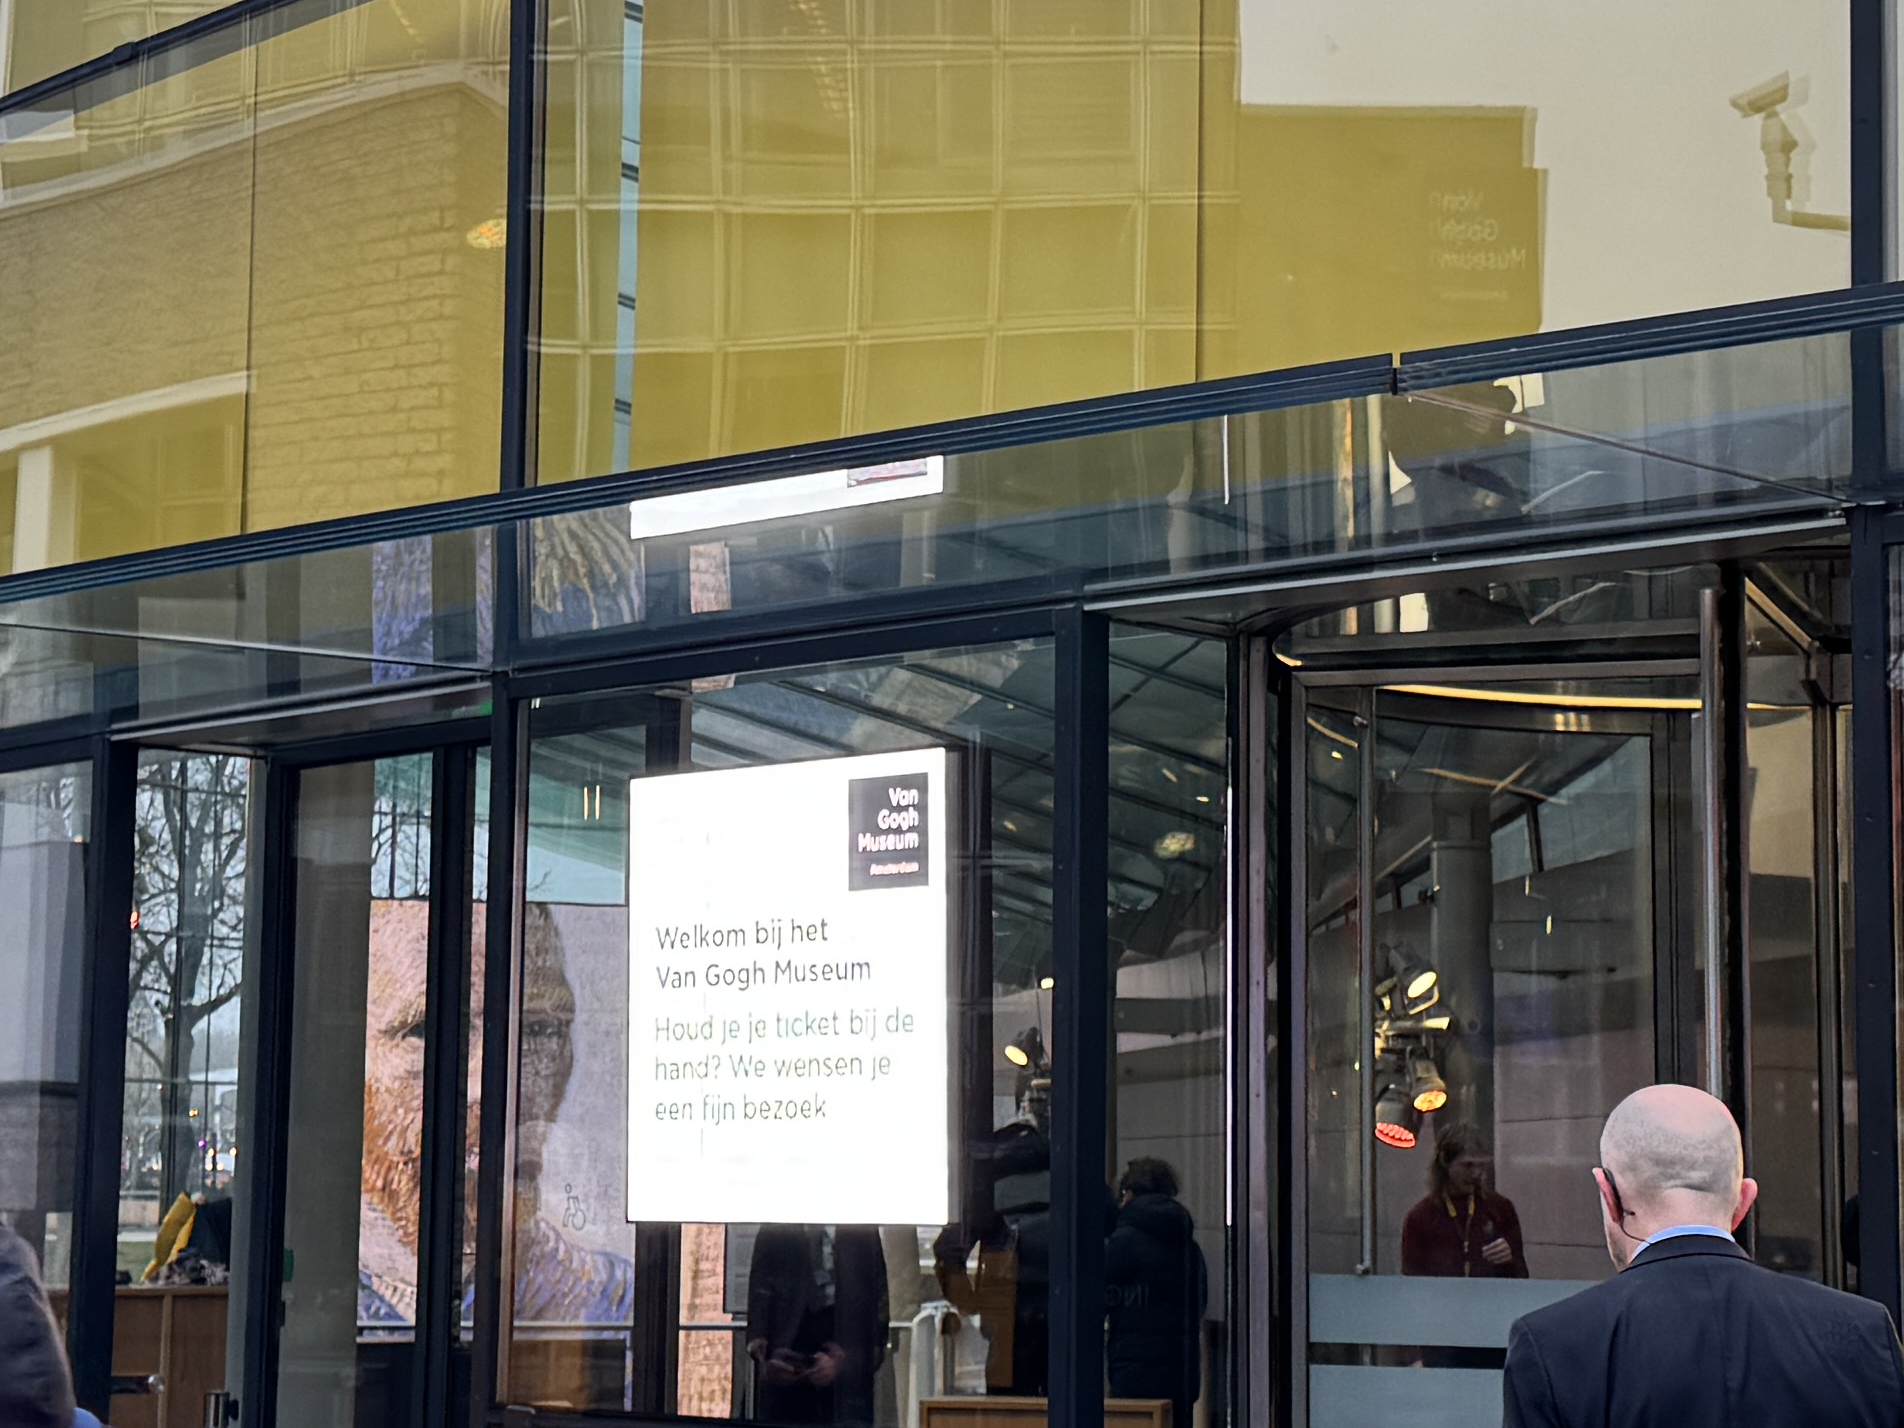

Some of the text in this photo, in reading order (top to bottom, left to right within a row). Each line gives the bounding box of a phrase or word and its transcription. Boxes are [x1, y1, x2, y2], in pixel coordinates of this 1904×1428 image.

[888, 786, 920, 807] Van
[877, 806, 920, 831] Gogh
[857, 831, 920, 853] Museum
[655, 917, 829, 951] Welkom bij het
[656, 959, 872, 991] Van Gogh Museum
[655, 1005, 914, 1046] Houd je je ticket bij de
[654, 1053, 892, 1081] hand? We wensen je
[654, 1091, 827, 1126] een fijn bezoek
